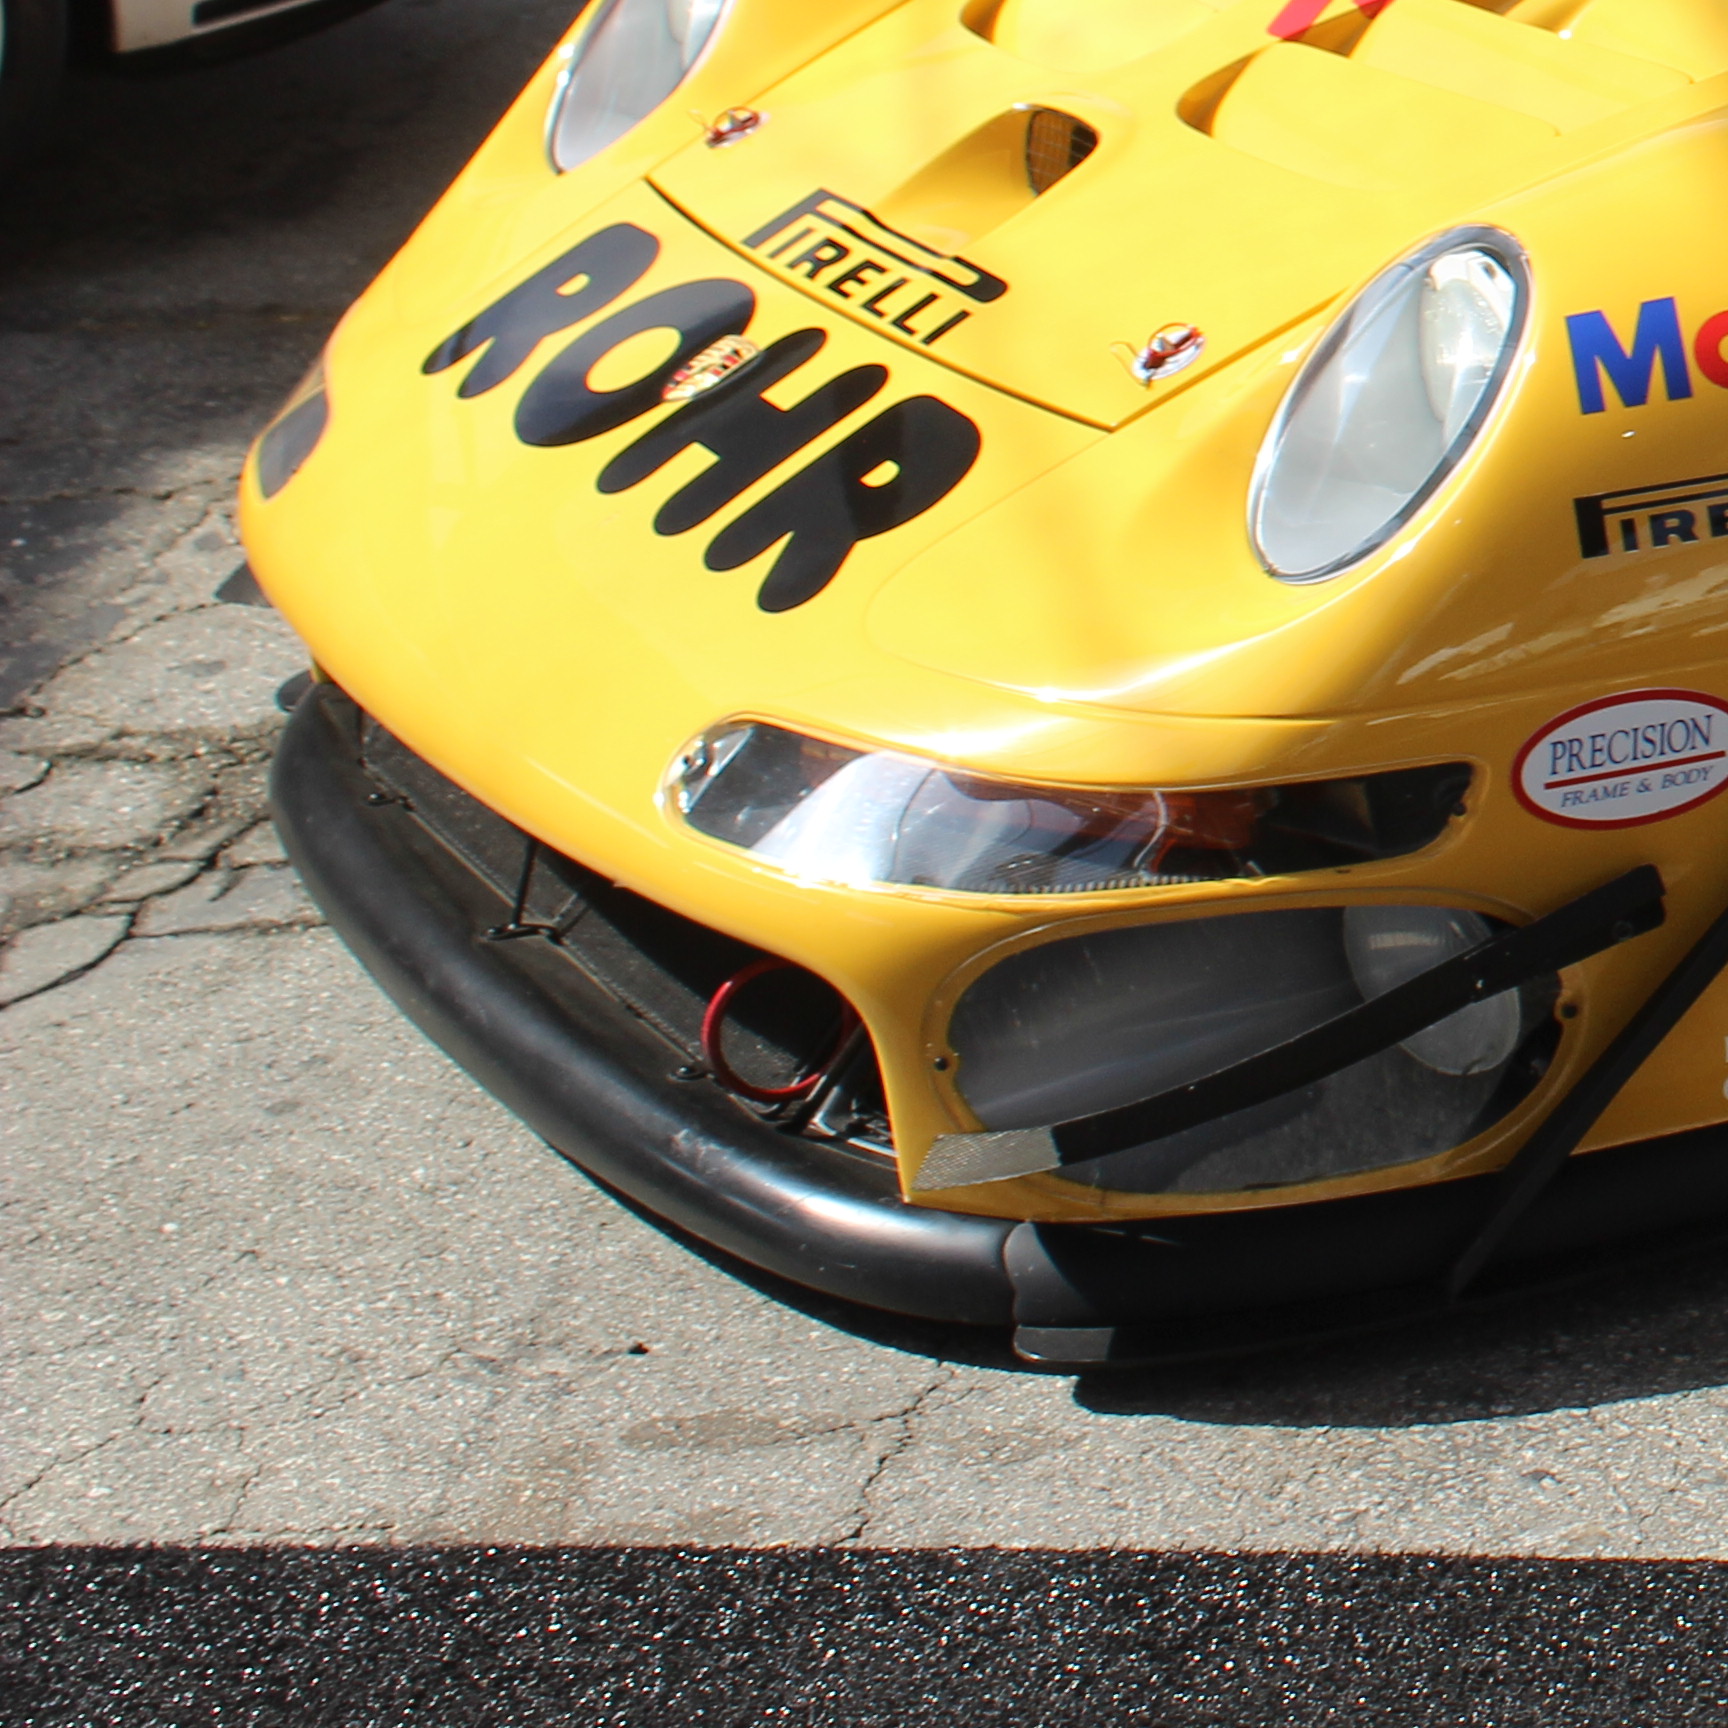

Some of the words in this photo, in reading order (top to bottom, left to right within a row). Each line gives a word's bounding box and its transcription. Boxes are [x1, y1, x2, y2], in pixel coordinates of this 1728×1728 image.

[740, 187, 1009, 346] PIRELLI
[420, 222, 983, 614] ROHR
[1548, 713, 1716, 776] PRECISION
[1560, 780, 1632, 809] FRAME
[1636, 777, 1653, 794] &
[1660, 764, 1715, 791] BODY
